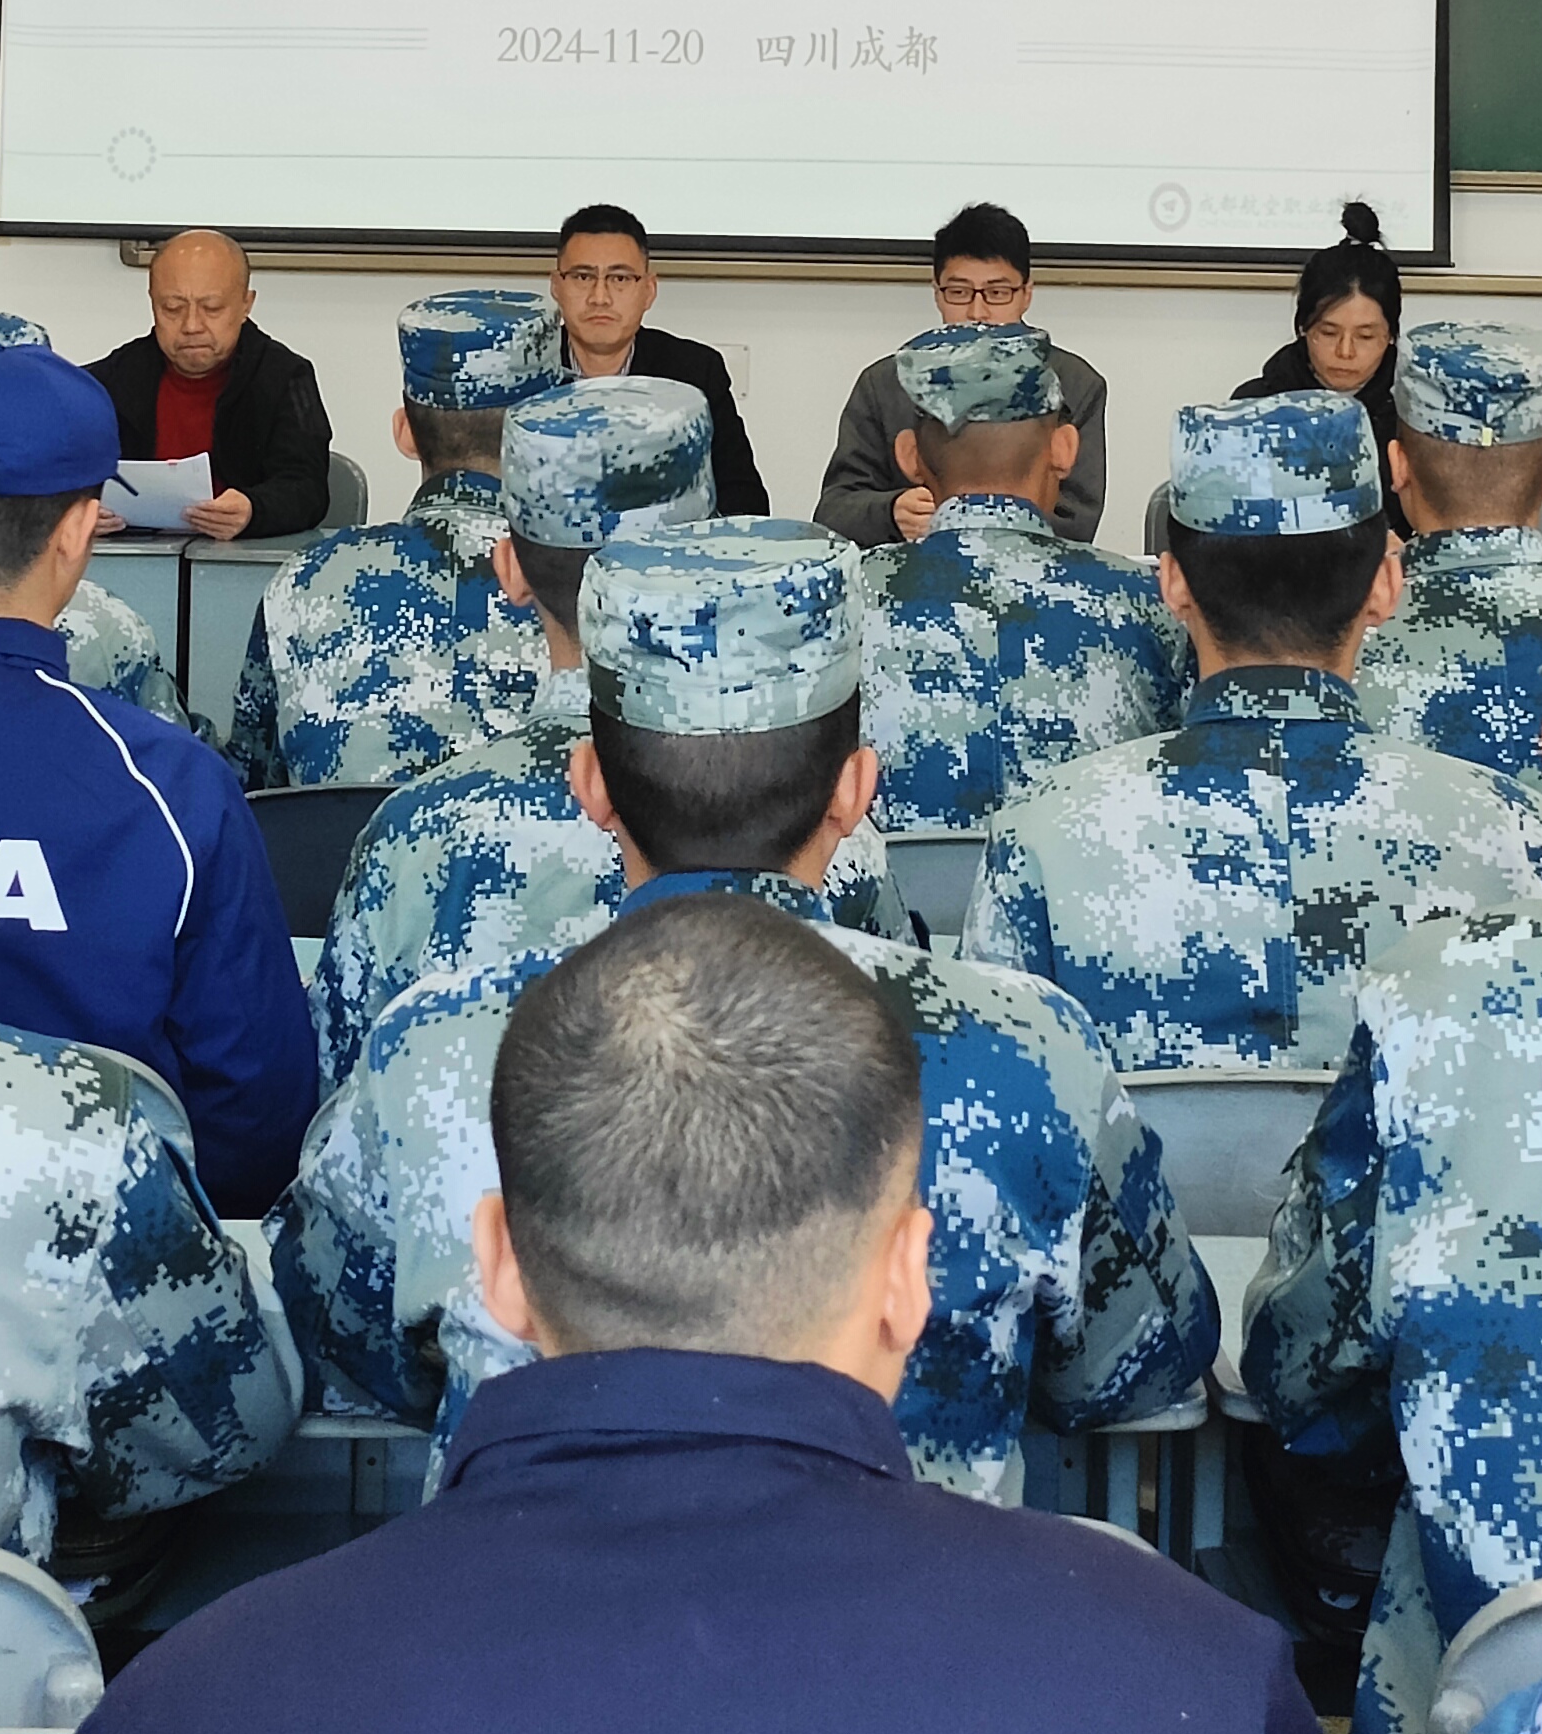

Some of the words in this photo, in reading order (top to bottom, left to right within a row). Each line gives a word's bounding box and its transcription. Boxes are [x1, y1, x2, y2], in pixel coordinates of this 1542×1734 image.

[496, 26, 705, 65] 2024-11-20
[756, 25, 940, 75] 四川成都
